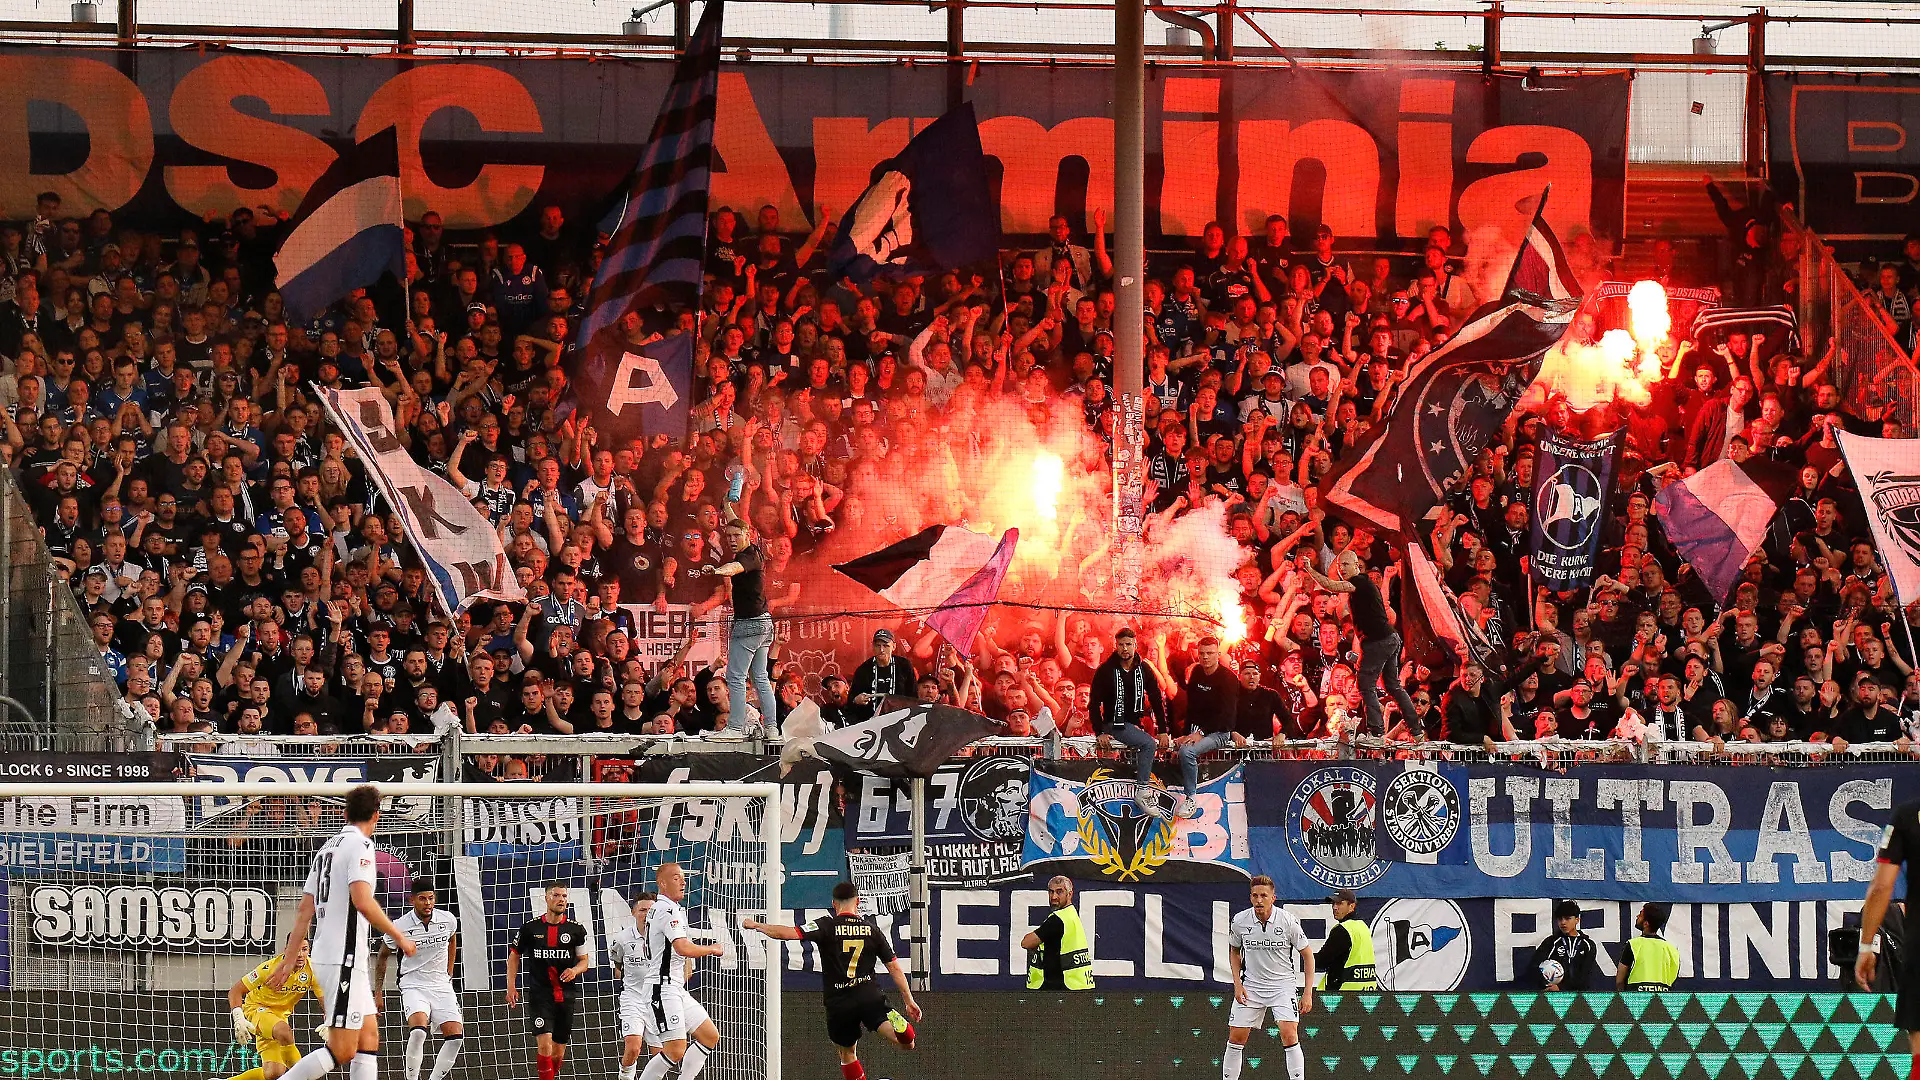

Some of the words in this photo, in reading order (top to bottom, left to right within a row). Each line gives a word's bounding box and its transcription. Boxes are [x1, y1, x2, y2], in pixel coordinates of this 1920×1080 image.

[0, 54, 545, 229] DSC
[1536, 549, 1558, 565] DIE
[45, 764, 53, 777] 6
[66, 765, 112, 778] SINCE
[116, 765, 150, 778] 1998
[1295, 770, 1344, 803] LOKAL
[1394, 771, 1452, 796] SEKTION
[71, 796, 150, 827] Firm
[1385, 808, 1458, 853] STADIONVERBOT
[1468, 777, 1893, 884] ULTRAS
[1310, 864, 1381, 887] BIELEFELD
[31, 886, 273, 946] SAMSON
[542, 949, 571, 959] BRITA
[842, 939, 865, 979] 7
